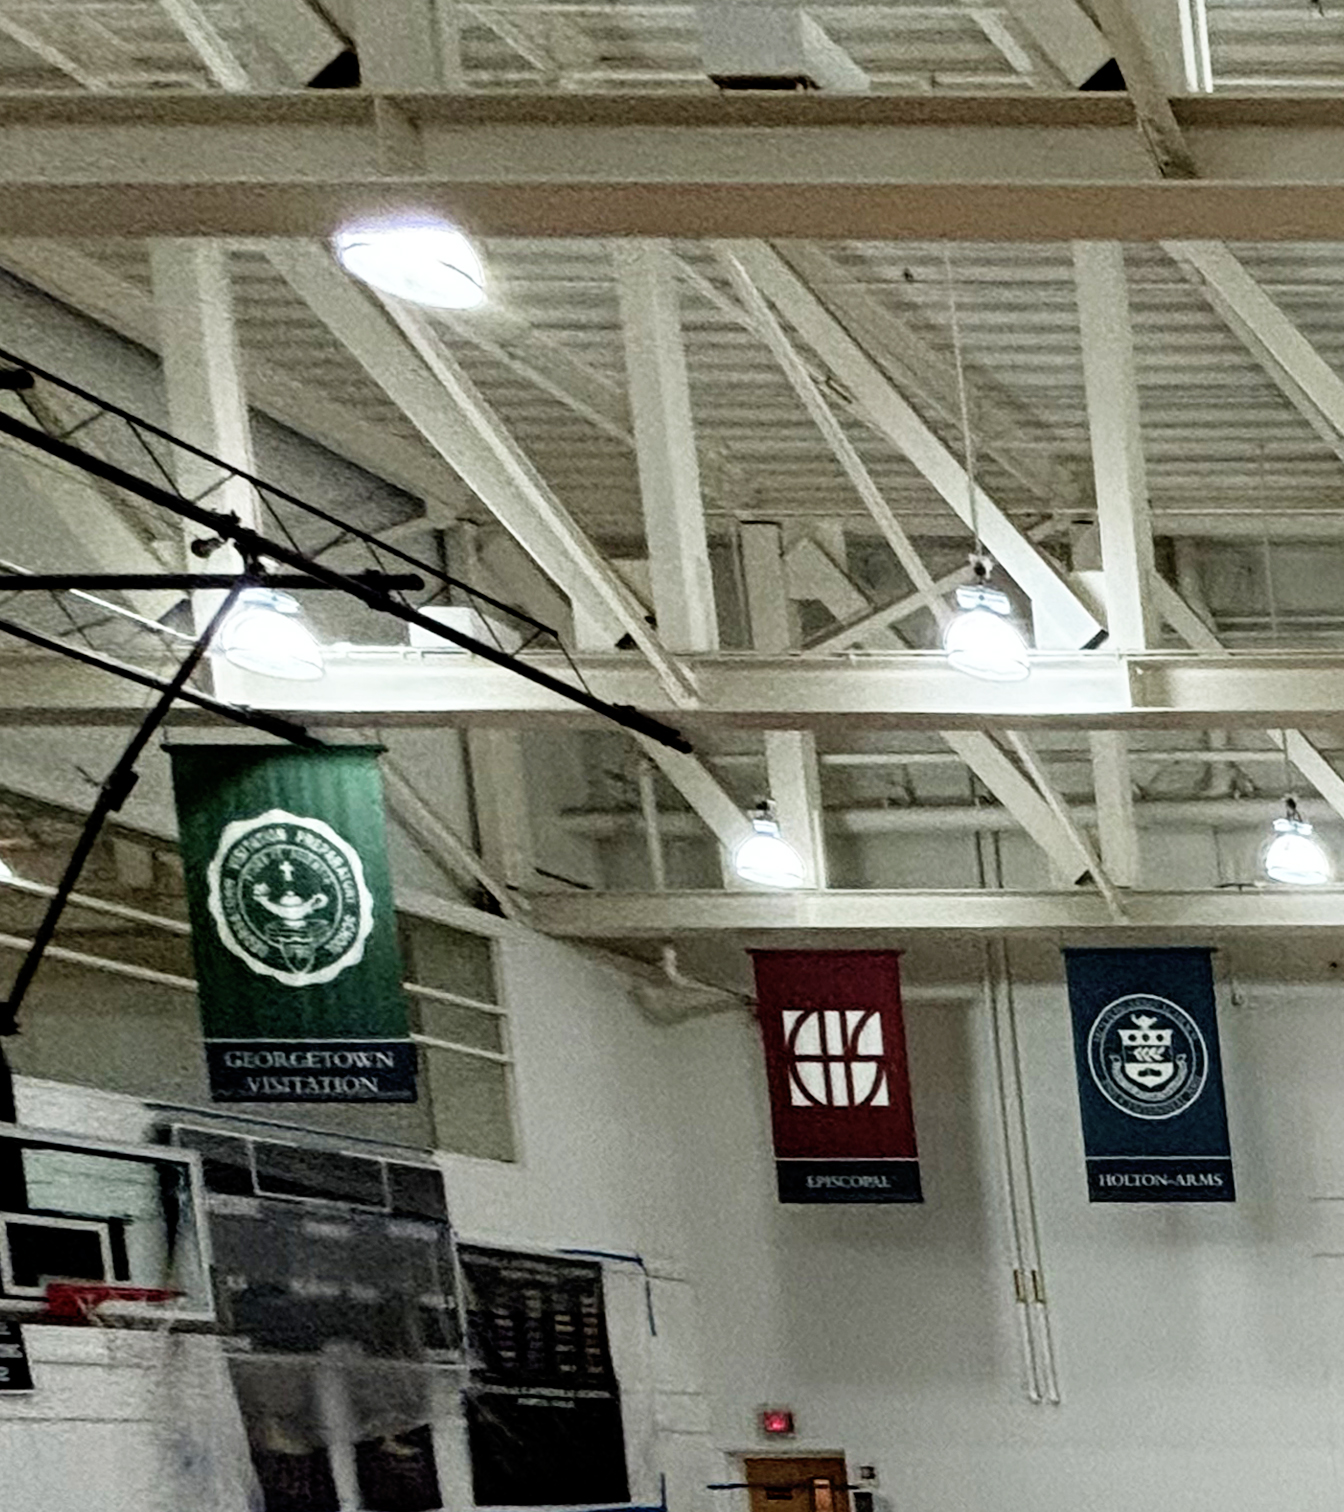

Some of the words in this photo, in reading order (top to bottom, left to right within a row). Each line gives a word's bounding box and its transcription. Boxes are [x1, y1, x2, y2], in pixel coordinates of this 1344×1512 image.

[225, 1050, 395, 1069] GEORGETOWN
[246, 1075, 380, 1093] VISITATION
[805, 1175, 892, 1189] EPISCOPAL
[1098, 1173, 1224, 1187] HOLTON-ARMS
